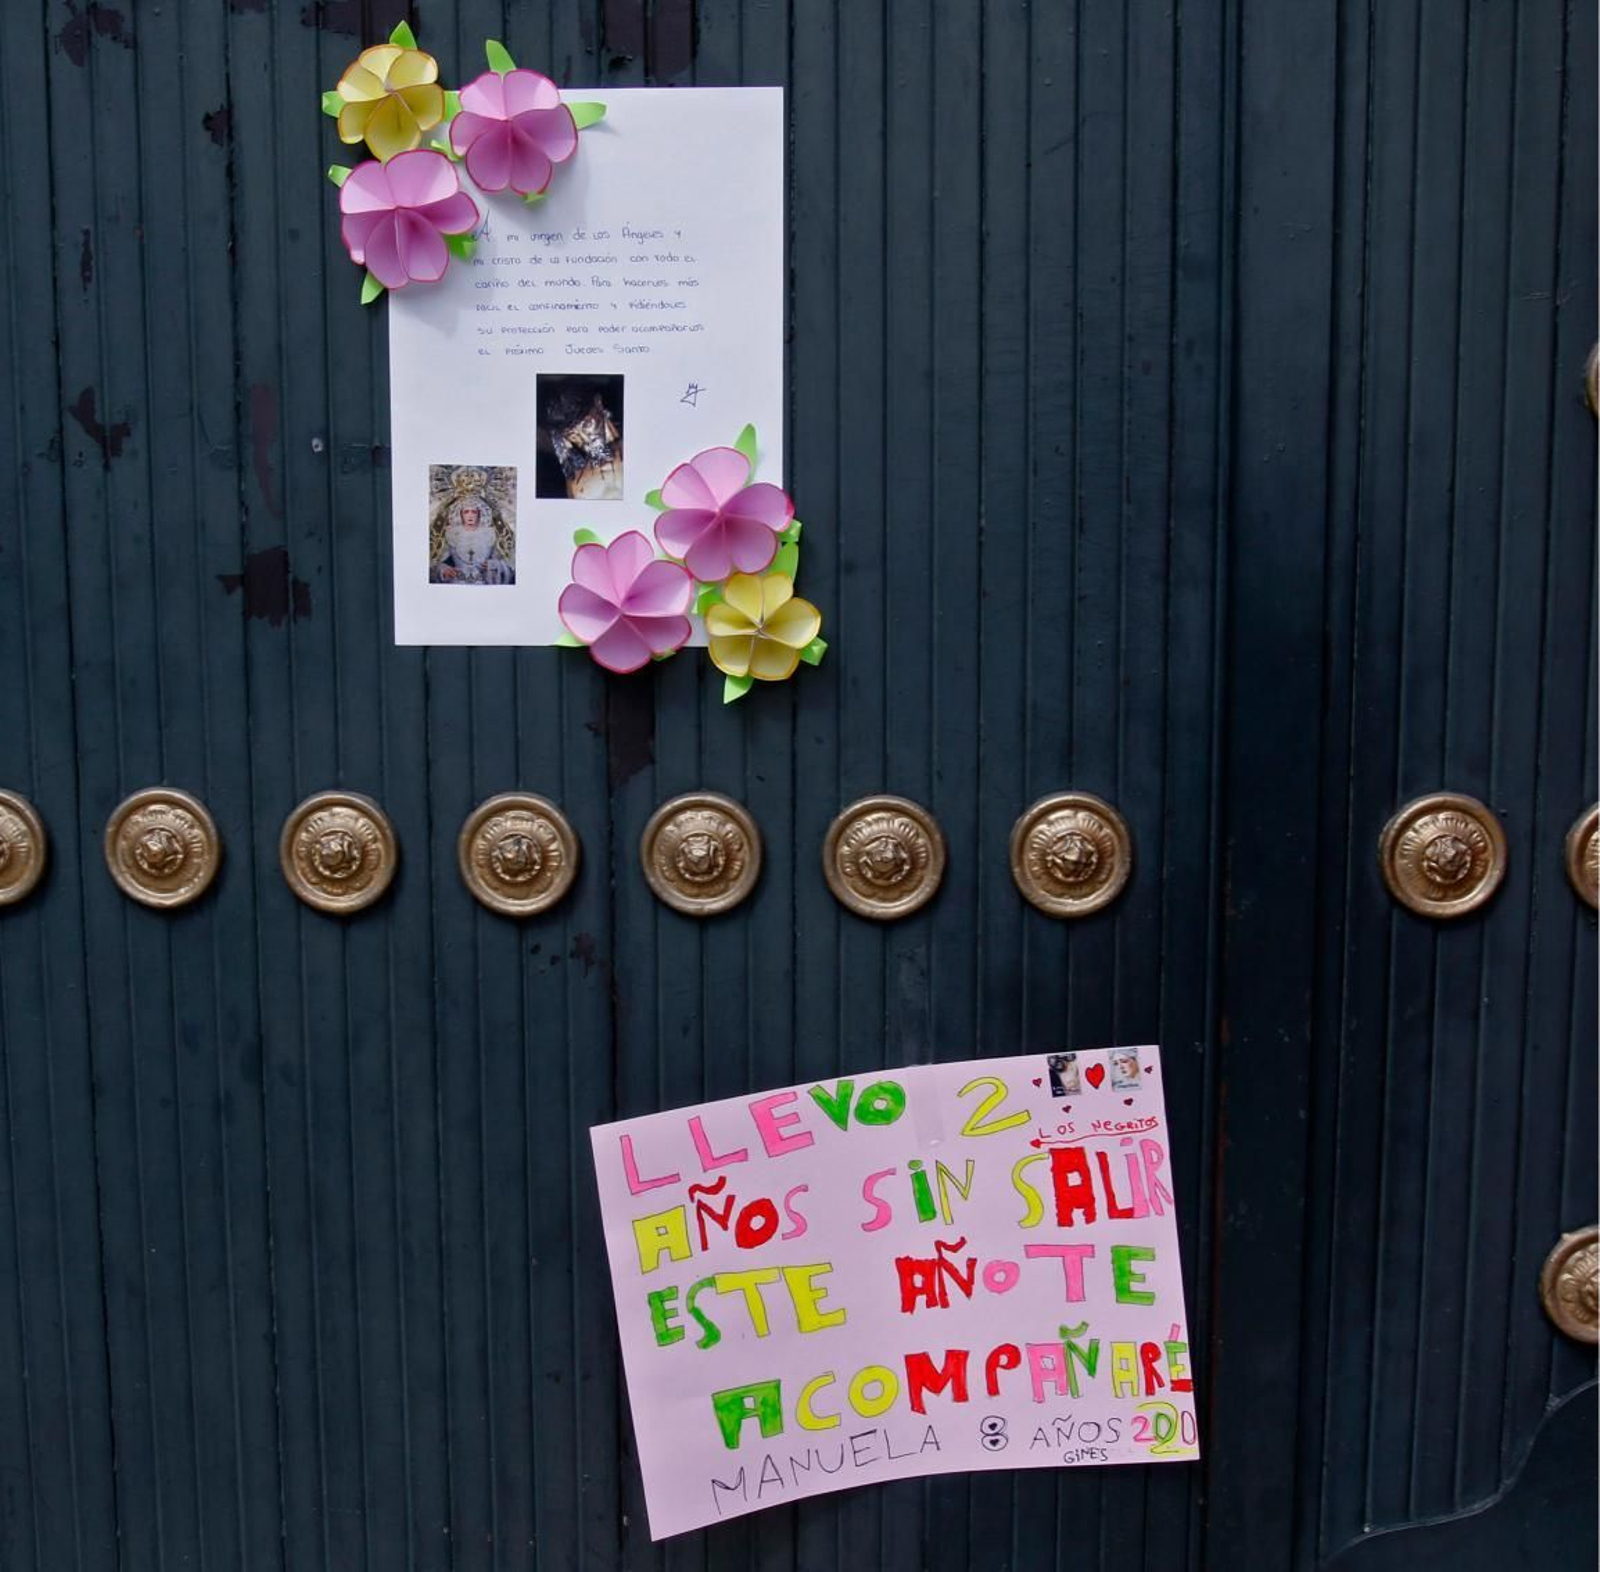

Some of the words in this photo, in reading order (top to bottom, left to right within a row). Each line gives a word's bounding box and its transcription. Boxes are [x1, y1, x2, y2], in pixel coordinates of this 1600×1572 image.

[473, 258, 485, 267] mi
[530, 255, 543, 264] de
[630, 255, 649, 263] con
[506, 234, 519, 242] mi
[573, 221, 586, 241] de
[675, 229, 682, 239] y
[678, 276, 700, 287] más
[620, 1079, 907, 1195] LLEVO
[957, 1077, 1032, 1137] 2
[1039, 1122, 1076, 1139] LOS
[632, 1175, 809, 1275] AÑOS
[647, 1262, 847, 1349] ESTE
[1024, 1244, 1156, 1306] TE
[711, 1323, 1195, 1450] ACOMPAÑARÉ
[710, 1424, 941, 1516] MANUELA
[980, 1415, 1009, 1453] 8
[1029, 1414, 1123, 1450] AÑOS
